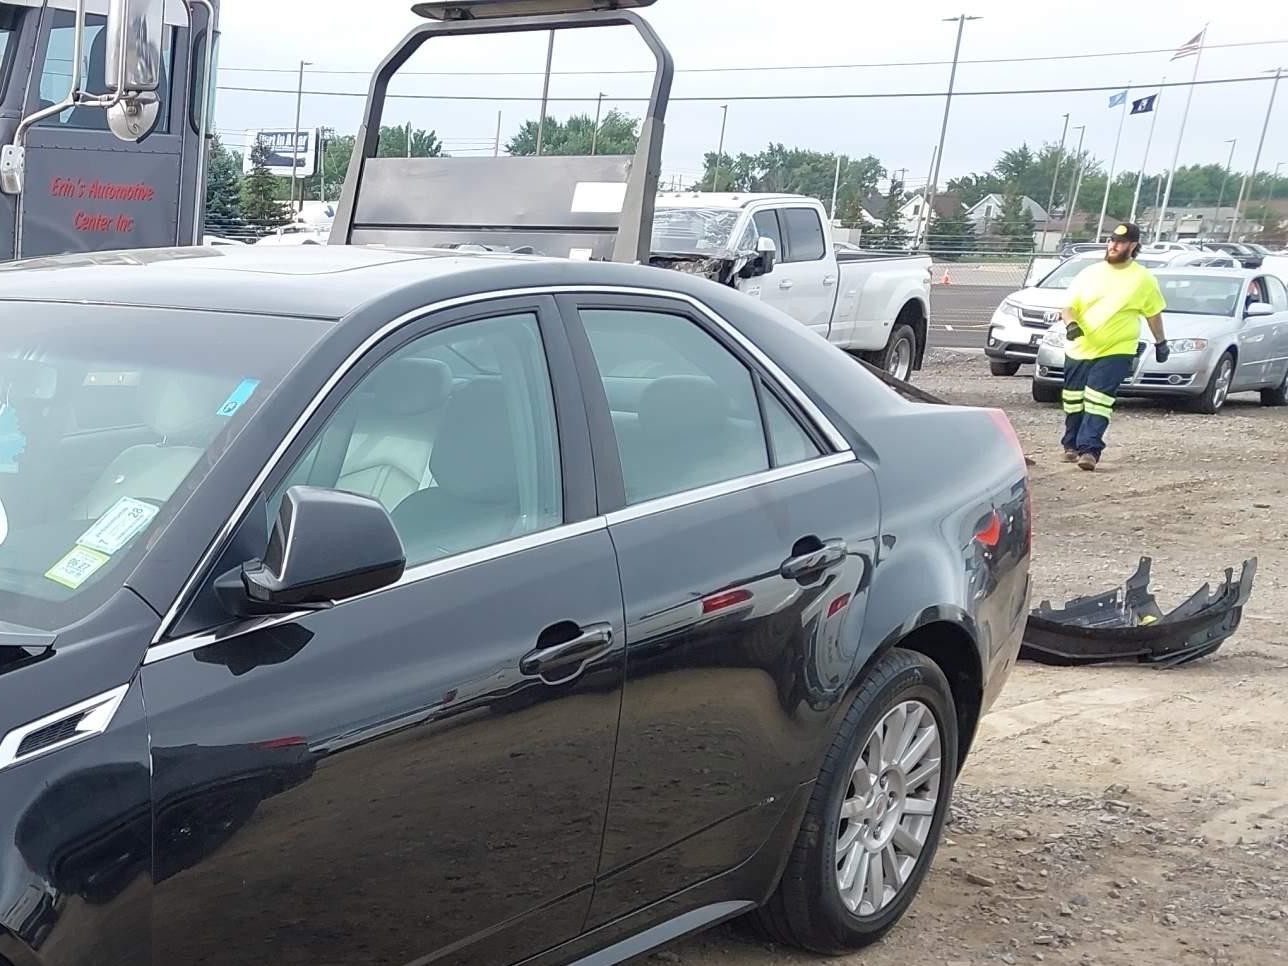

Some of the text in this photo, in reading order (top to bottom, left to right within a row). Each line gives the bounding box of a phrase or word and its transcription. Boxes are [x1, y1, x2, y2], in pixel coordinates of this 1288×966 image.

[51, 177, 154, 201] Erin's Automotive
[74, 210, 135, 232] Center Inc
